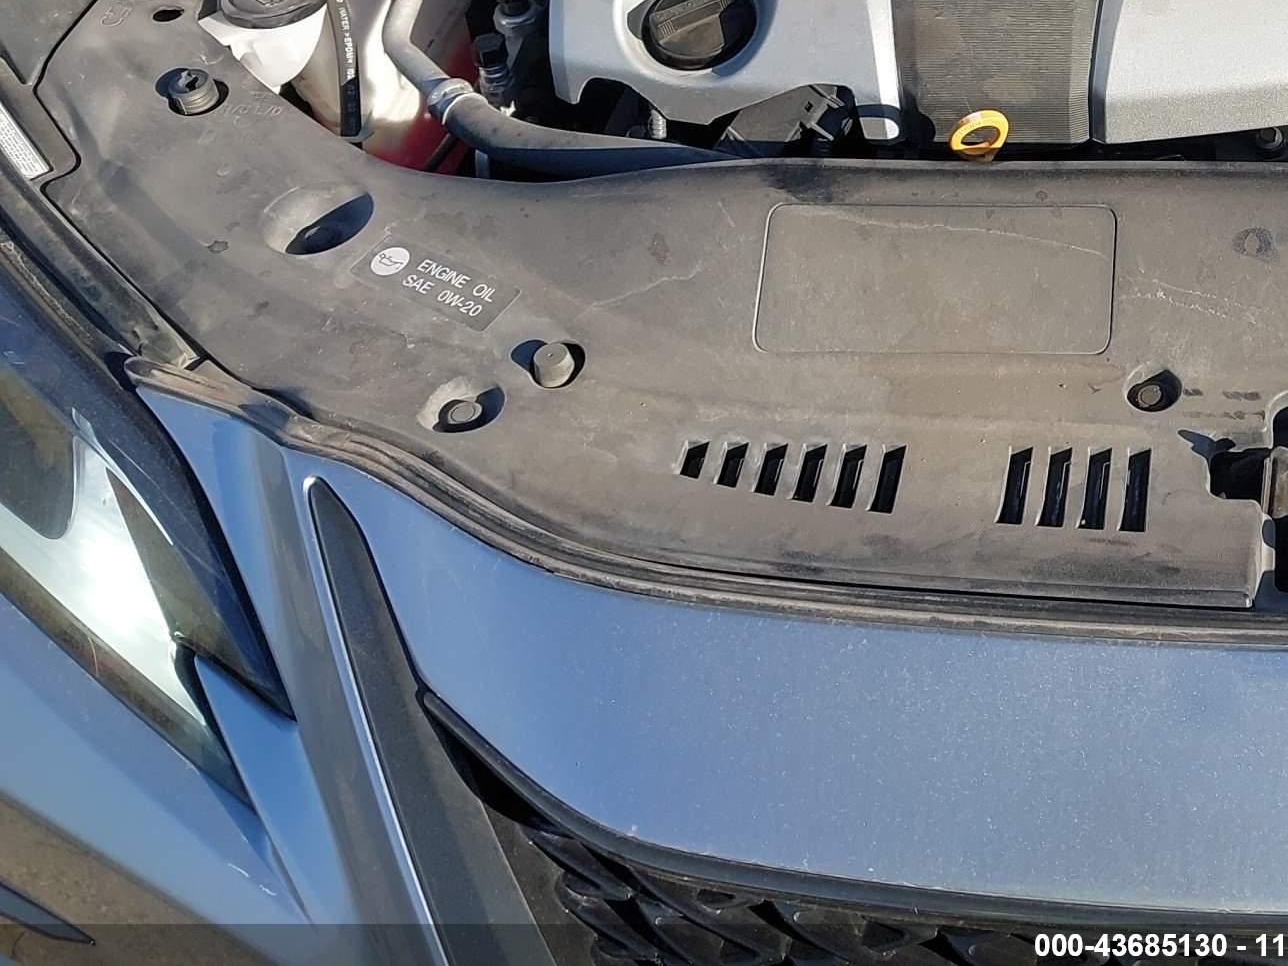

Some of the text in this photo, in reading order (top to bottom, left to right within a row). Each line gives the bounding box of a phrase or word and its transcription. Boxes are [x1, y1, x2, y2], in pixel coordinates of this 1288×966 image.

[402, 274, 483, 317] SAE 0W-20
[417, 259, 497, 303] ENGINE OIL
